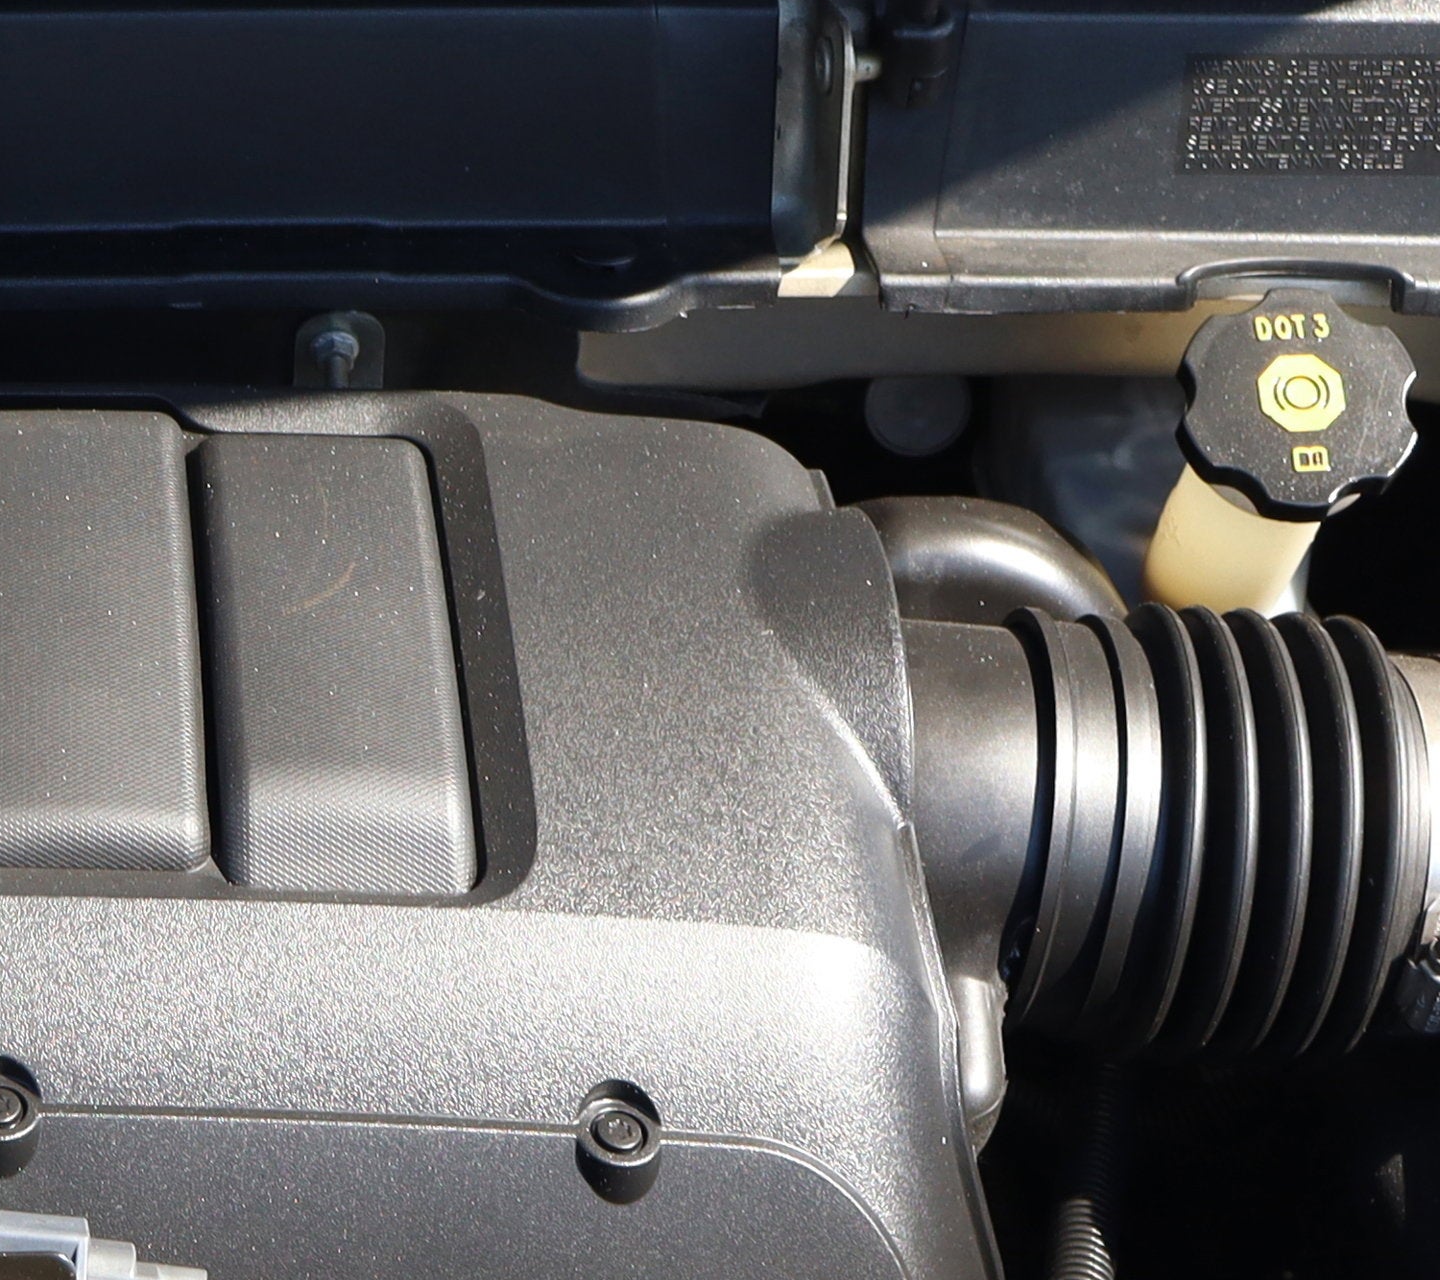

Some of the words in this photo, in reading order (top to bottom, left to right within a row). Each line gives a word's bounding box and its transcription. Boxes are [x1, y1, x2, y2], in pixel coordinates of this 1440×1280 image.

[1286, 59, 1343, 77] CLEAN
[1349, 59, 1405, 77] FILLER
[1193, 78, 1228, 96] USE
[1232, 78, 1279, 96] ONLY
[1283, 78, 1319, 96] DOT
[1336, 78, 1385, 96] FLUID
[1390, 78, 1440, 96] FROM
[1253, 313, 1305, 341] DOT
[1312, 312, 1331, 339] 3
